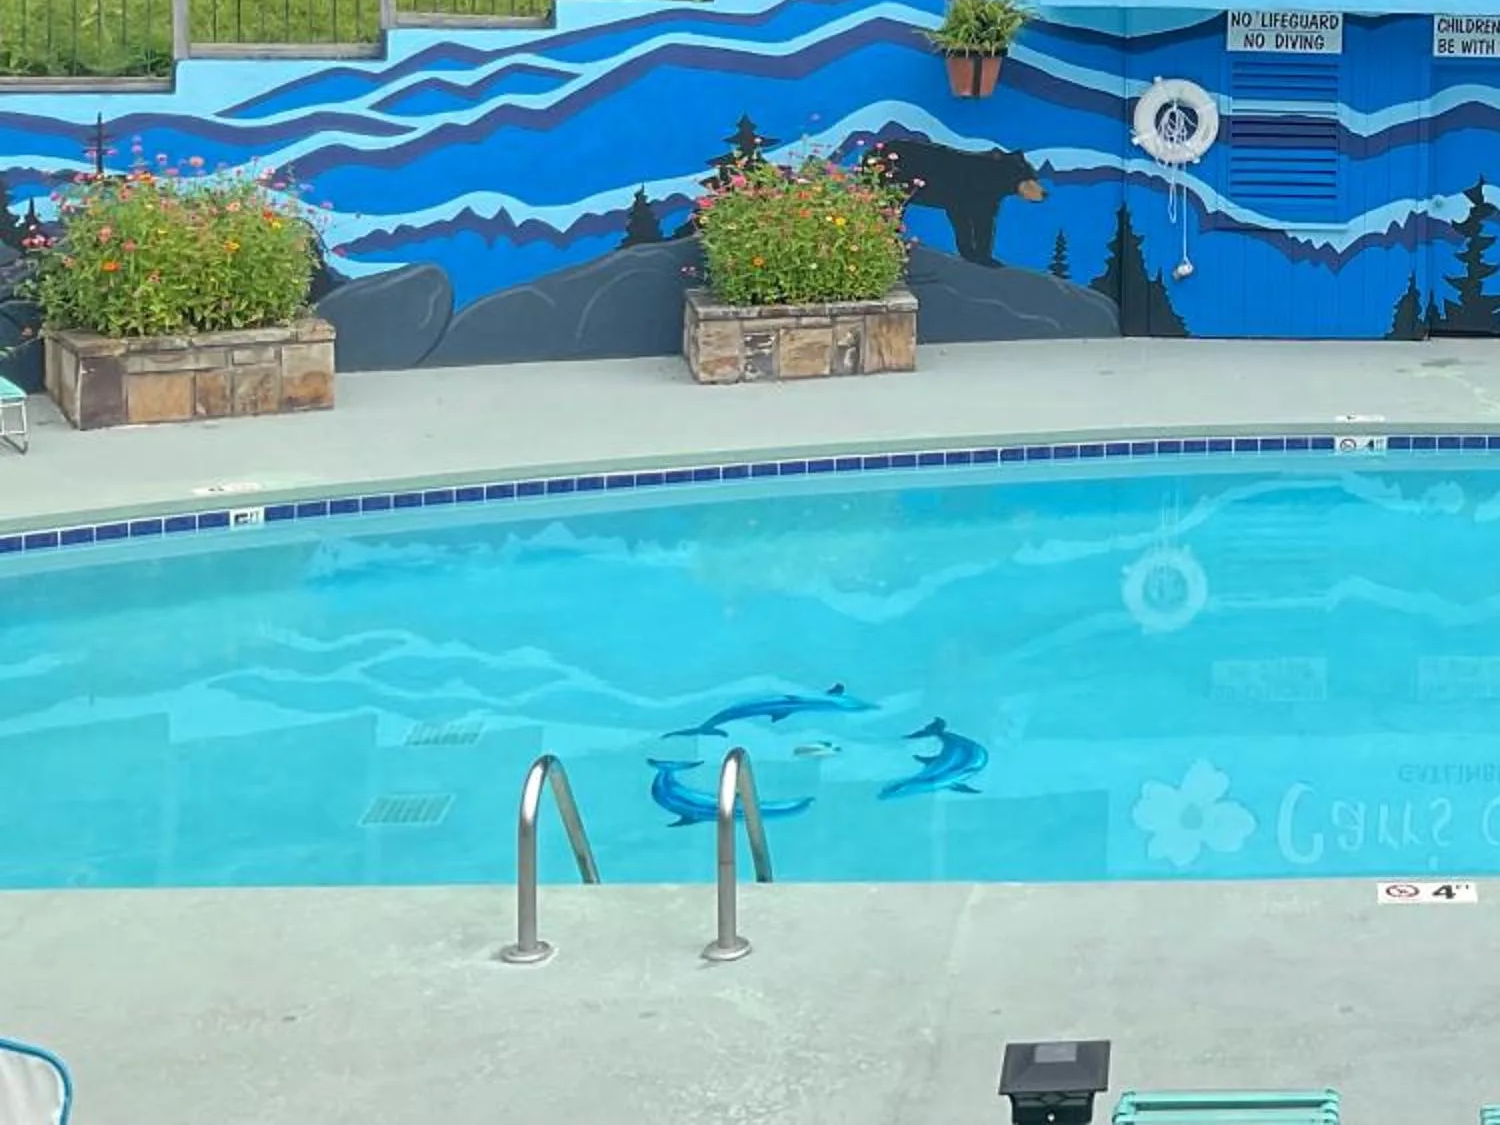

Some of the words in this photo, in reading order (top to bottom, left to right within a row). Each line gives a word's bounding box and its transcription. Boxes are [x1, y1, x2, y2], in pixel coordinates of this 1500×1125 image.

[1231, 12, 1252, 28] NO
[1261, 13, 1339, 30] LIFEGUARD
[1438, 18, 1500, 35] CHILDREN
[1243, 33, 1265, 48] NO
[1275, 33, 1325, 50] DIVING
[1438, 38, 1455, 54] BE
[1461, 39, 1495, 54] WITH
